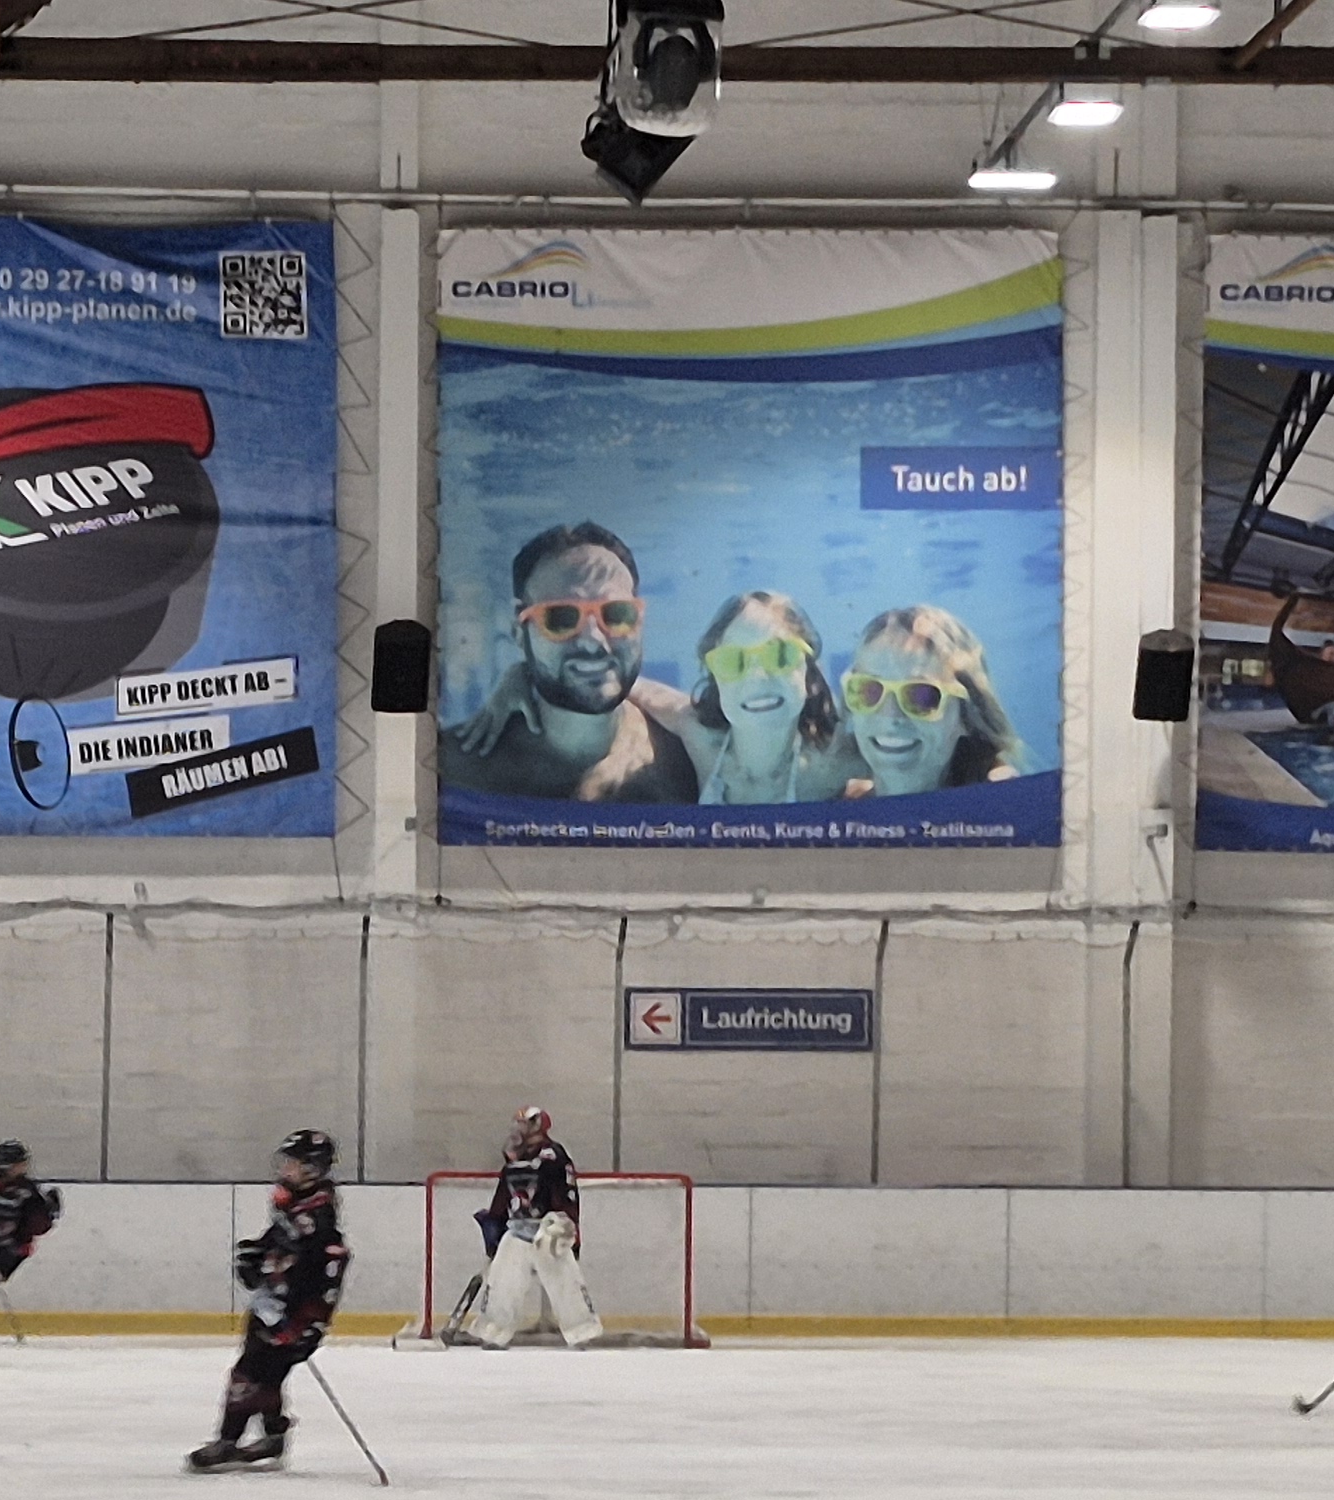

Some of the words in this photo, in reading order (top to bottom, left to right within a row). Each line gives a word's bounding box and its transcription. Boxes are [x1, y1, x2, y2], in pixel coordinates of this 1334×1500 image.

[20, 267, 49, 291] 29
[57, 269, 123, 293] 27-18
[131, 271, 157, 294] 91
[168, 273, 197, 294] 19
[14, 458, 154, 517] KIPP
[891, 464, 975, 492] Tauch
[983, 464, 1028, 492] ab!
[126, 682, 171, 706] KIPP
[177, 674, 238, 701] DECKT
[244, 671, 270, 693] AB
[79, 740, 112, 764] DIE
[117, 729, 213, 760] INDIANER
[161, 755, 249, 799] RÄUMEN
[251, 744, 288, 775] AB!
[711, 822, 771, 840] Events,
[775, 822, 824, 839] Kurse
[828, 822, 840, 839] &
[845, 822, 906, 839] Fitness
[701, 1006, 852, 1034] Laufrichtung
